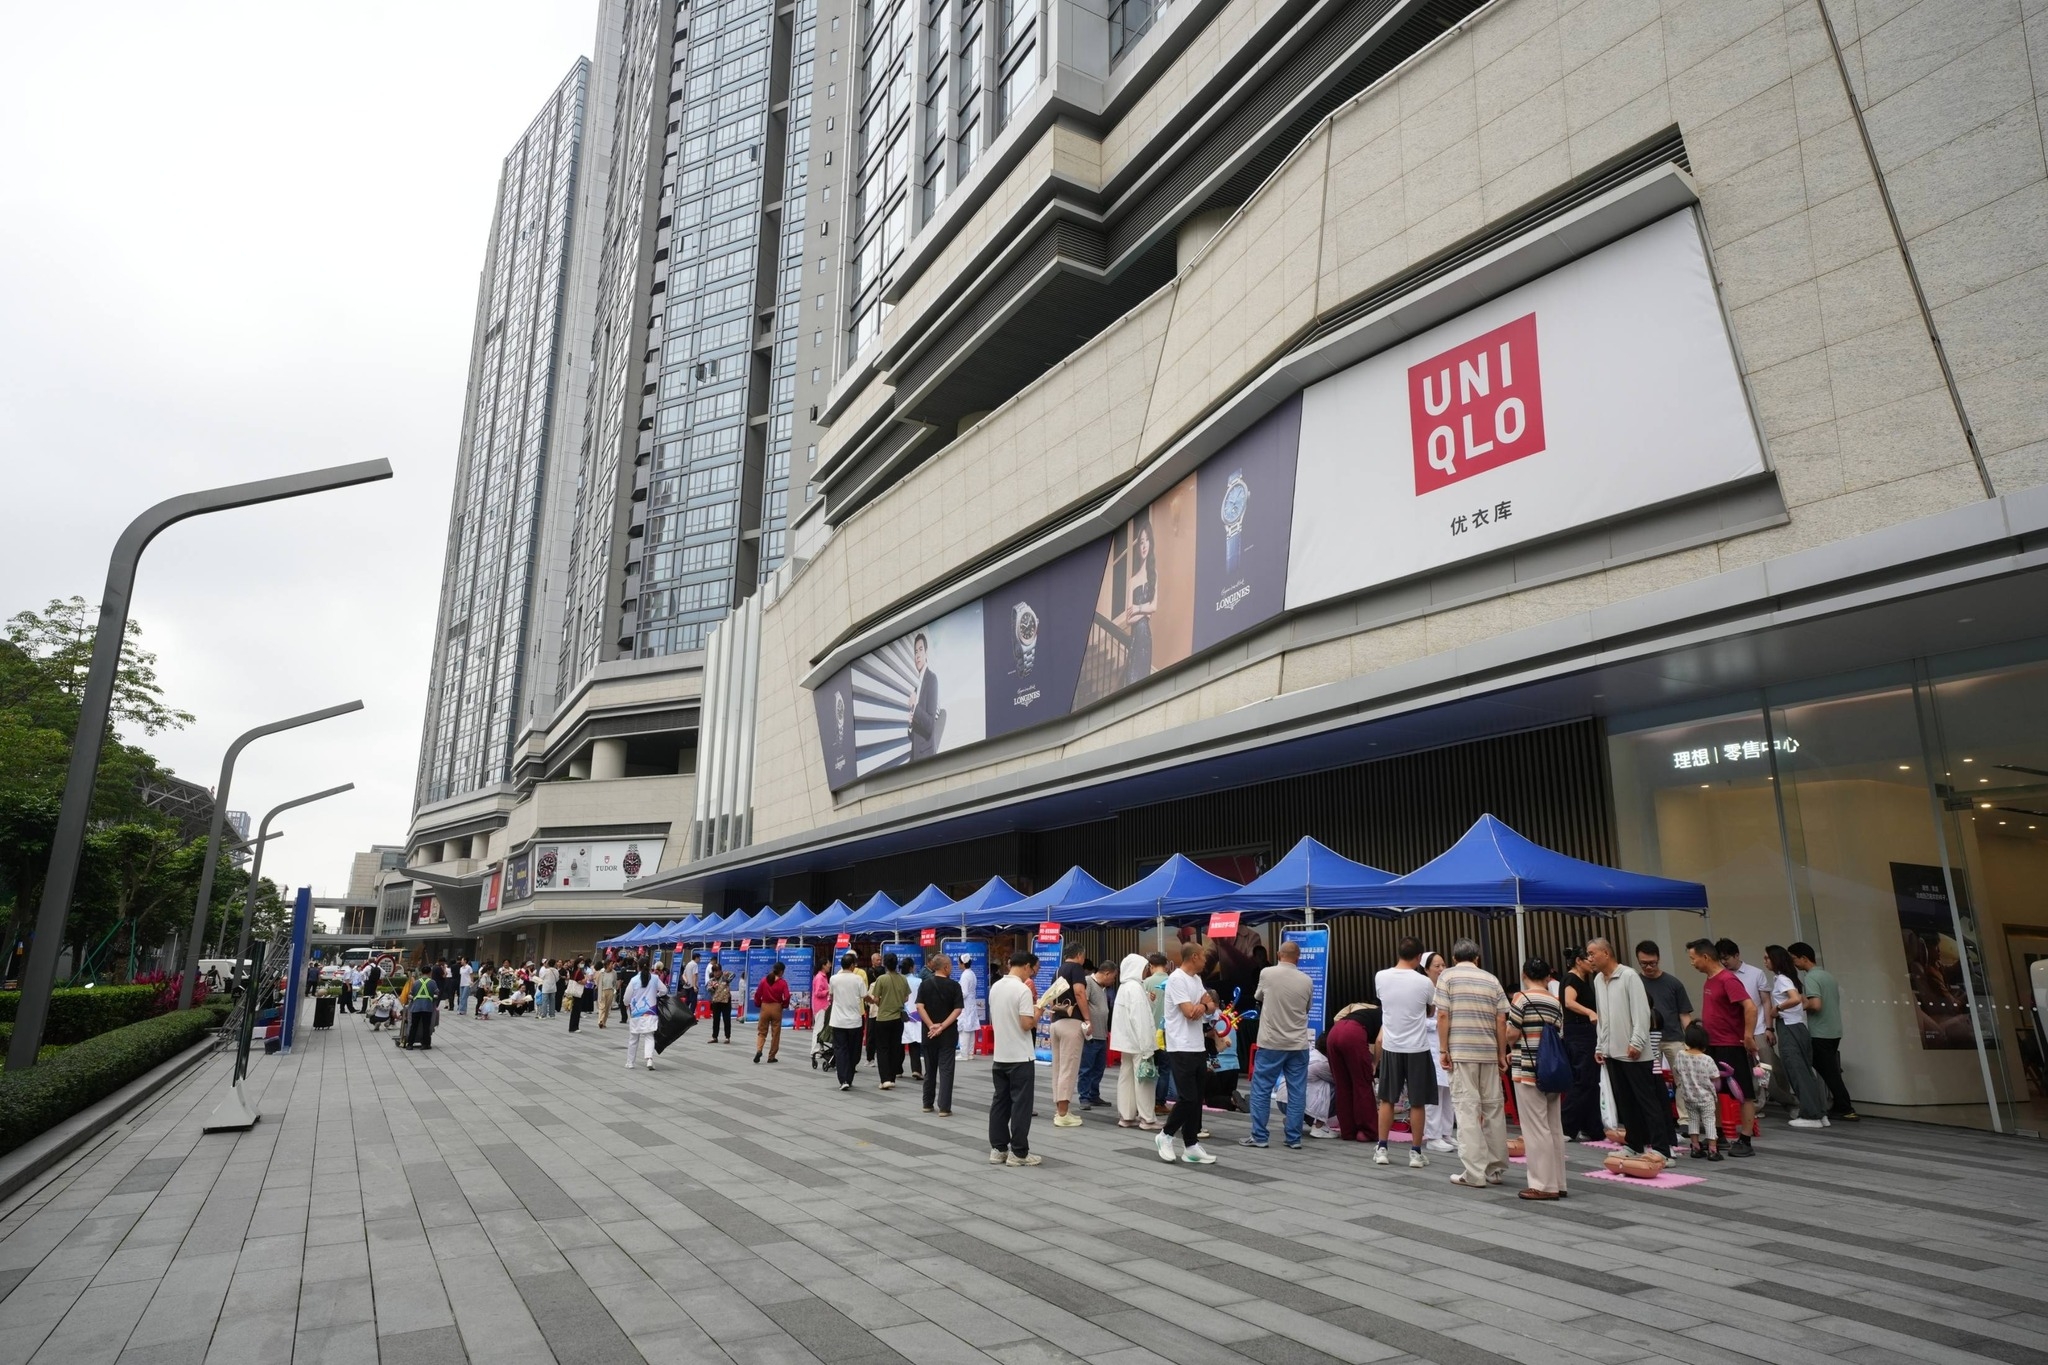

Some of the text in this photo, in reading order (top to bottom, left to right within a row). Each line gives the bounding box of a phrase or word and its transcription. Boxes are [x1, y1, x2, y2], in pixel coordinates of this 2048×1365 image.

[1423, 342, 1512, 416] UNI
[1428, 397, 1526, 475] QLO
[1450, 501, 1512, 536] 优衣库
[1215, 585, 1250, 611] LONGINES
[1013, 690, 1041, 706] LONGINES
[1673, 748, 1710, 769] 理想
